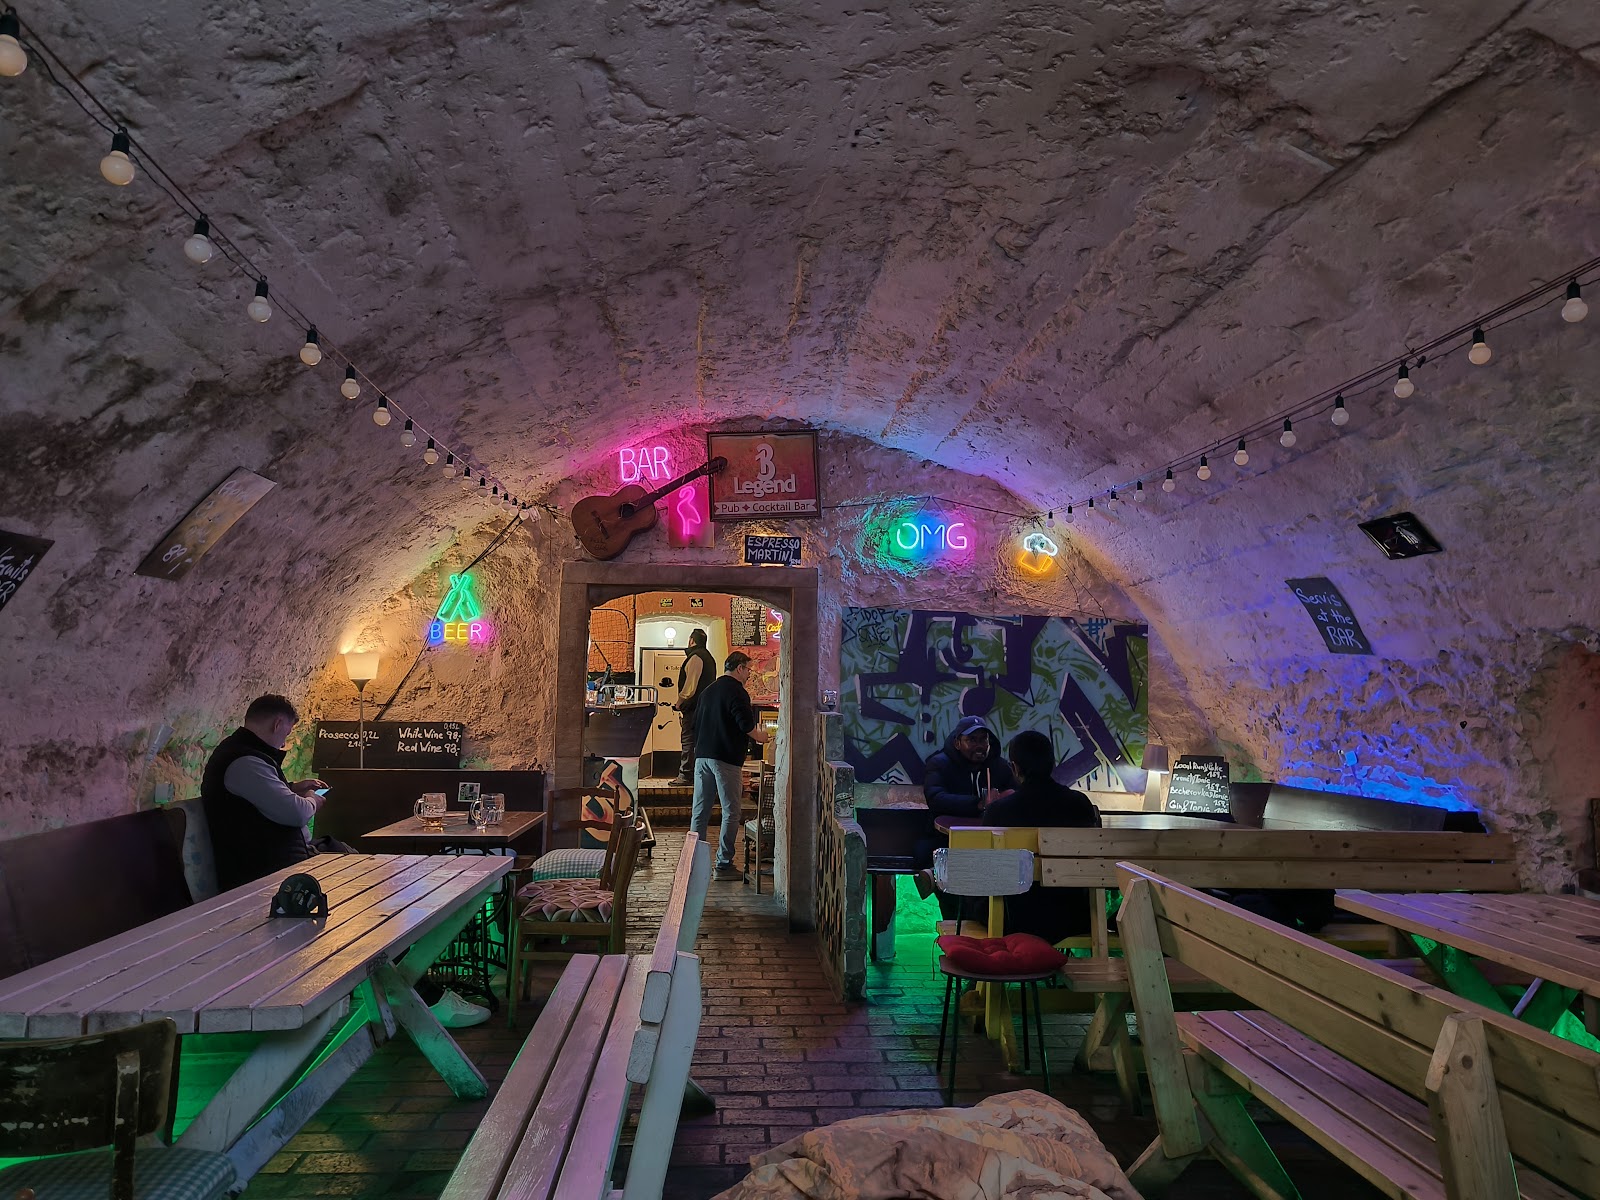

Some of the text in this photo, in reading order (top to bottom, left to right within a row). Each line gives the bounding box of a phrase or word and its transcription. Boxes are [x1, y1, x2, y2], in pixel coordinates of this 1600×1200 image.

[619, 446, 671, 482] BAR
[733, 473, 796, 497] Legend
[721, 501, 810, 512] Pub Cocktail Bar
[747, 536, 800, 550] ESPRESSO
[896, 522, 968, 549] OMG
[1317, 608, 1353, 625] at the
[430, 623, 482, 640] BEER
[1326, 626, 1363, 649] BAR
[318, 728, 360, 740] Prosecco
[398, 727, 423, 739] White
[424, 728, 444, 740] Wine
[397, 741, 418, 753] Red
[420, 741, 443, 753] Wine
